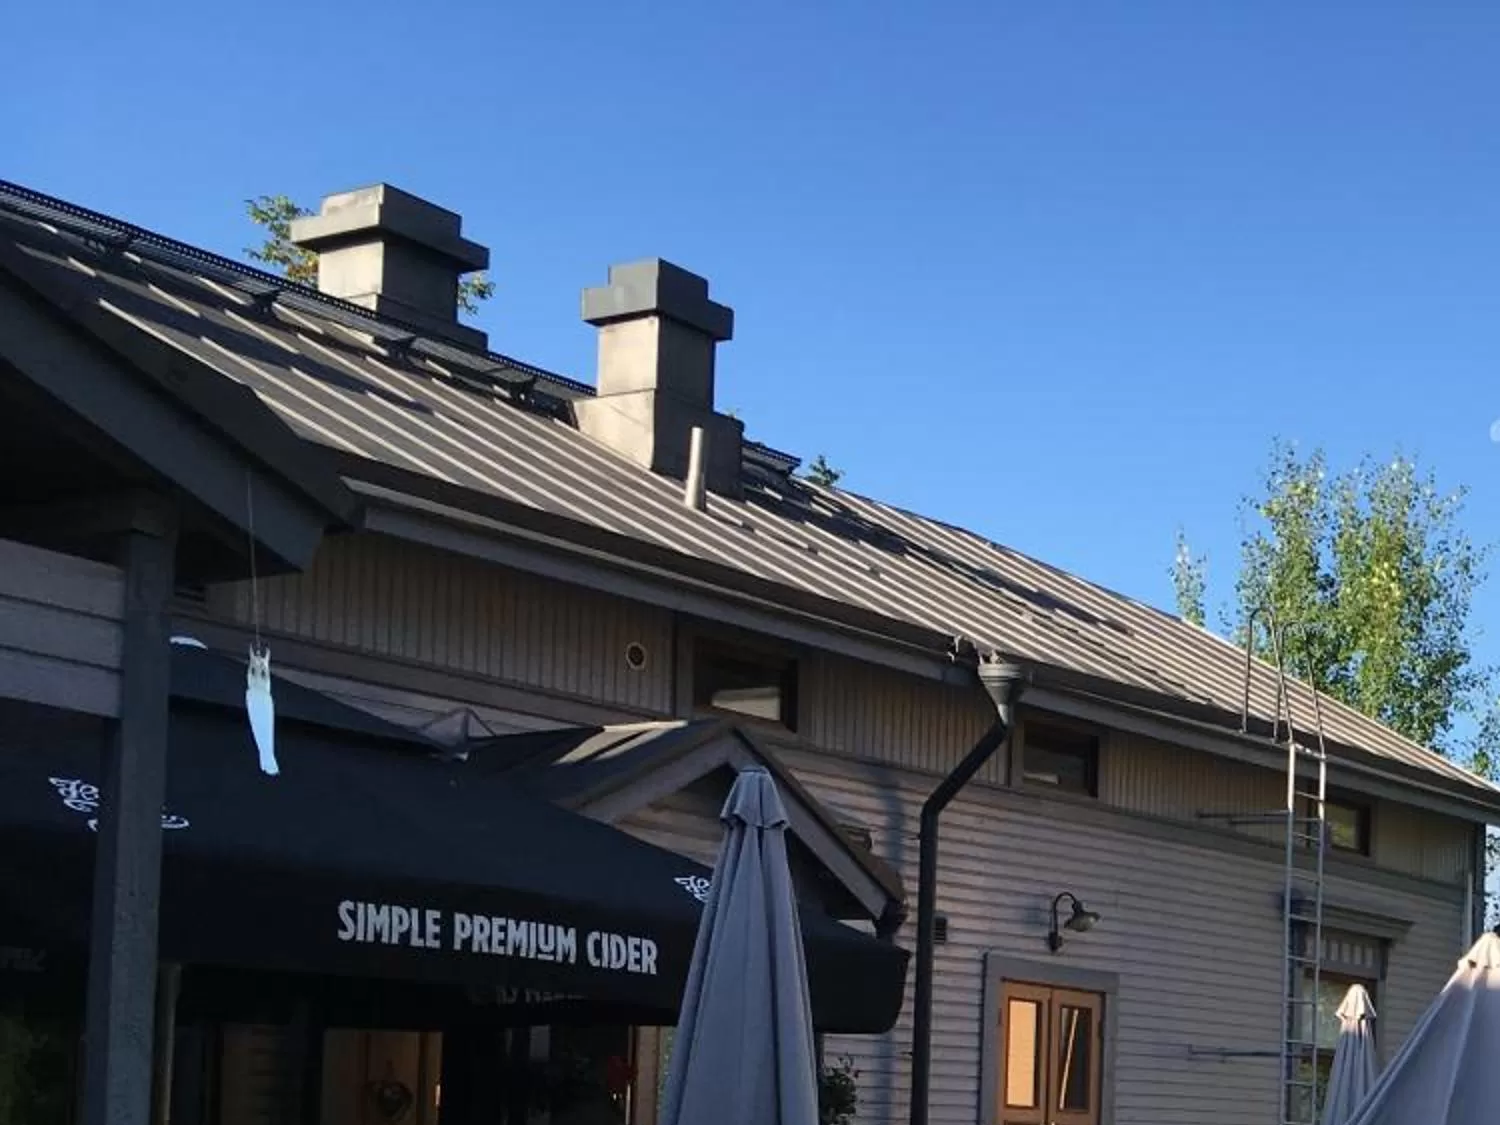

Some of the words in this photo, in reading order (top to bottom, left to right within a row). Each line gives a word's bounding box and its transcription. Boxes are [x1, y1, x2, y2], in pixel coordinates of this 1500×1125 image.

[337, 899, 442, 949] SIMPLE
[452, 912, 577, 965] PREMIUM
[586, 931, 658, 976] CIDER
